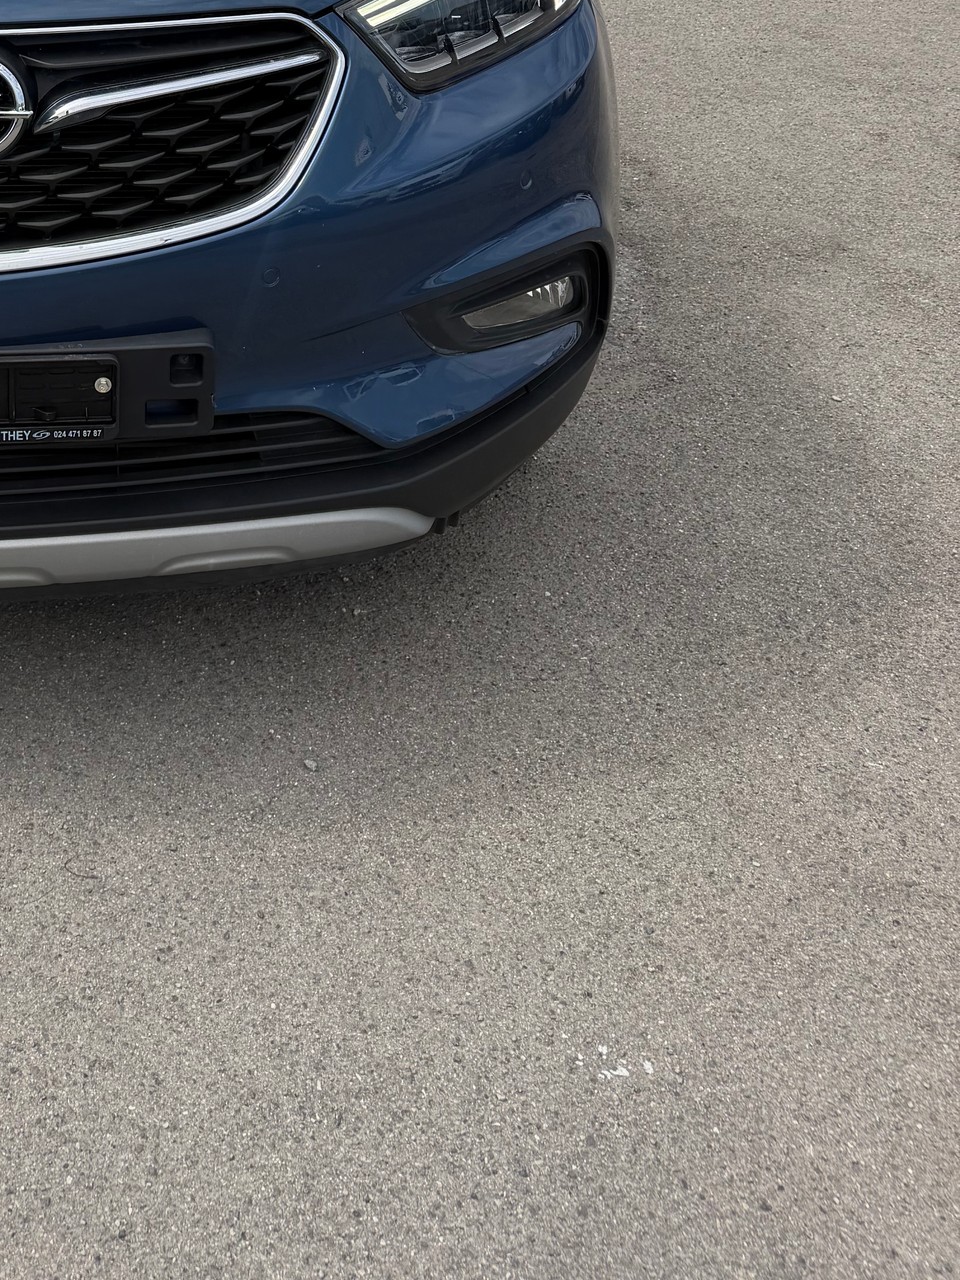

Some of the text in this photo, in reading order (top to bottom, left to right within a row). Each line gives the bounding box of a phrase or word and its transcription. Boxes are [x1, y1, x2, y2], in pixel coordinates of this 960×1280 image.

[53, 430, 67, 438] 024
[68, 430, 81, 438] 471
[93, 429, 102, 437] 87
